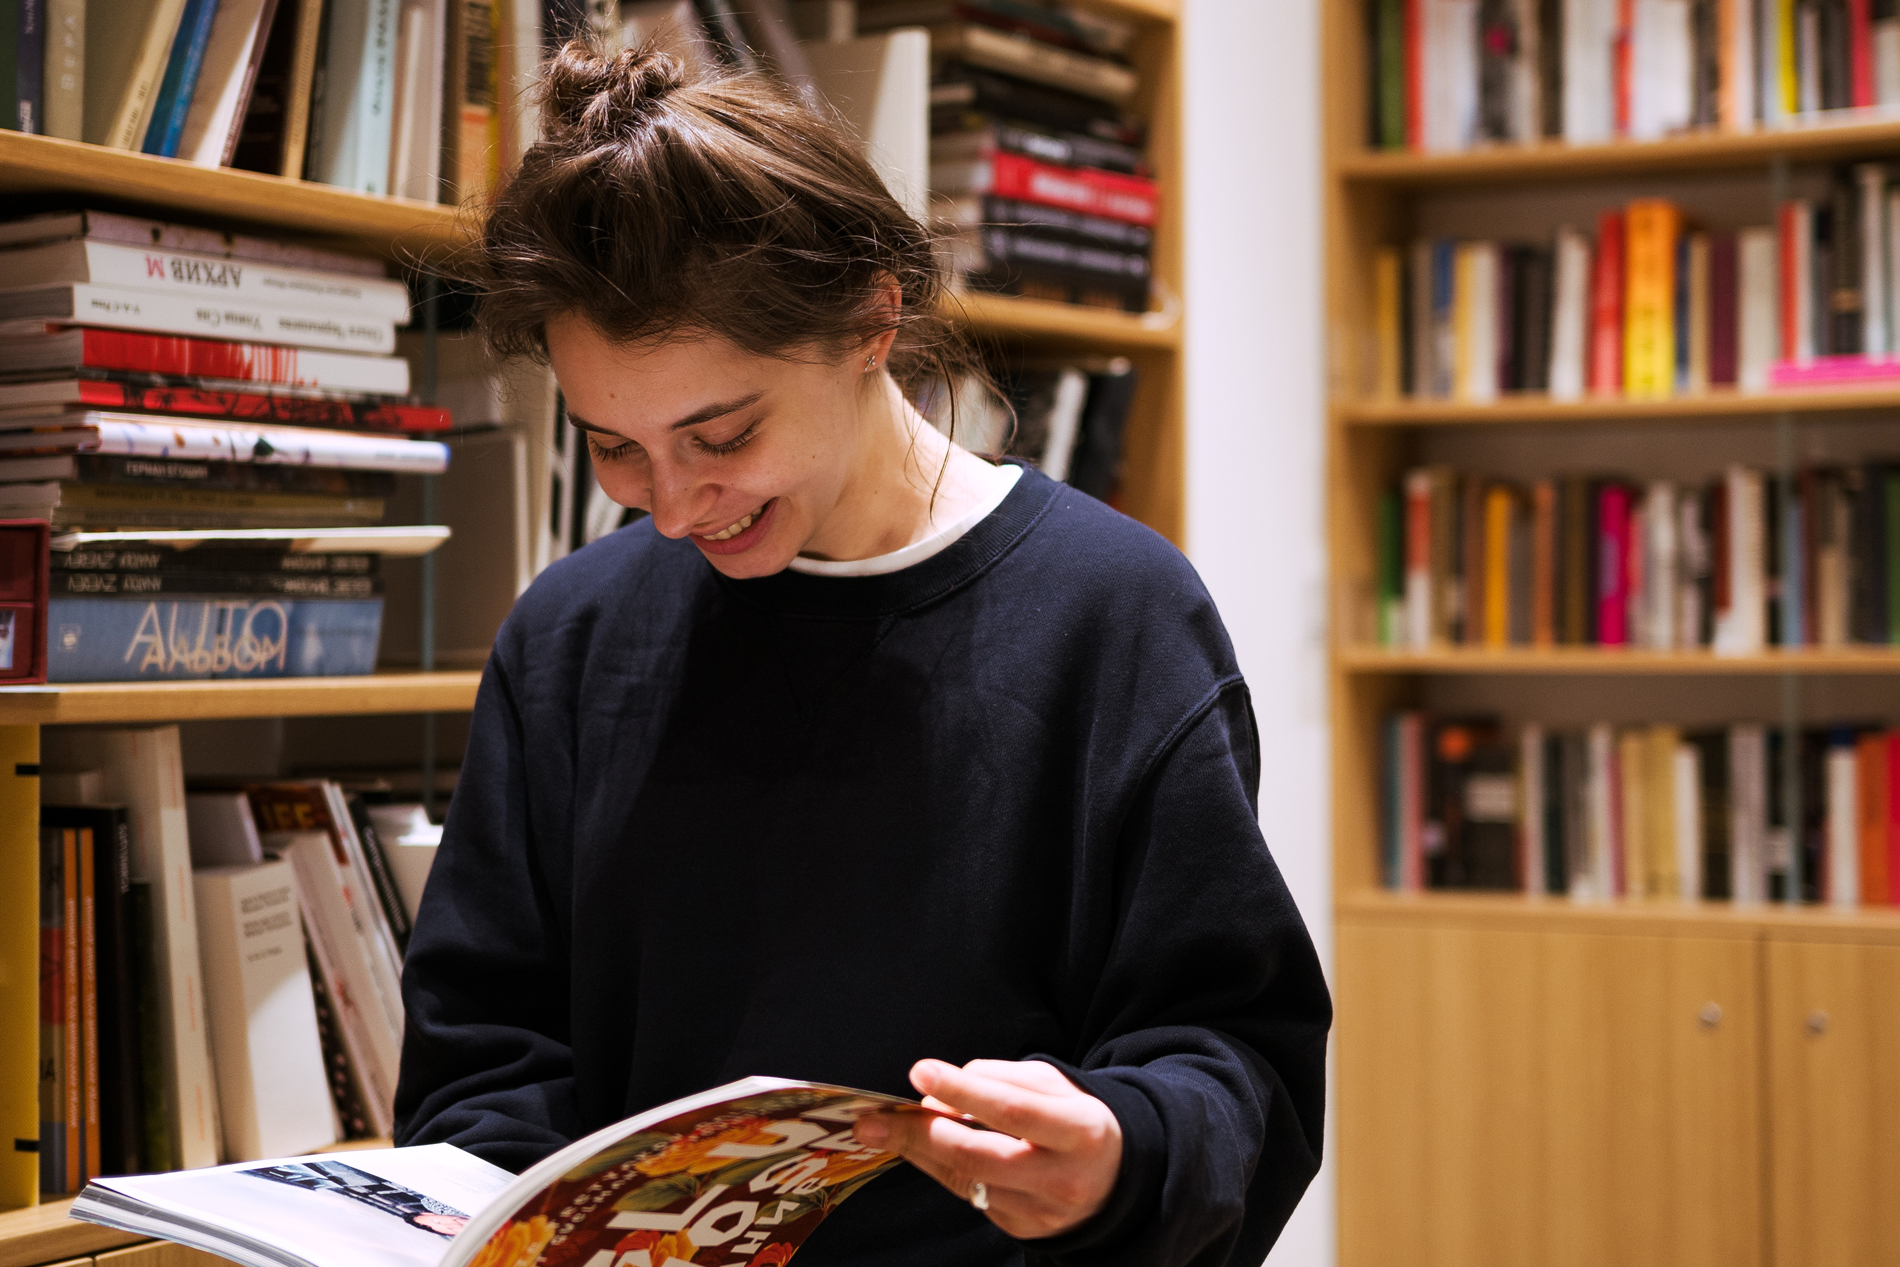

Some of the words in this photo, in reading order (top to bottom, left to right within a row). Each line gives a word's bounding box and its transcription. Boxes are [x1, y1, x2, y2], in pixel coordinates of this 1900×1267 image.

[172, 259, 242, 289] АРХИВ
[124, 600, 288, 664] AUTO
[550, 1169, 639, 1247] GUELMAN
